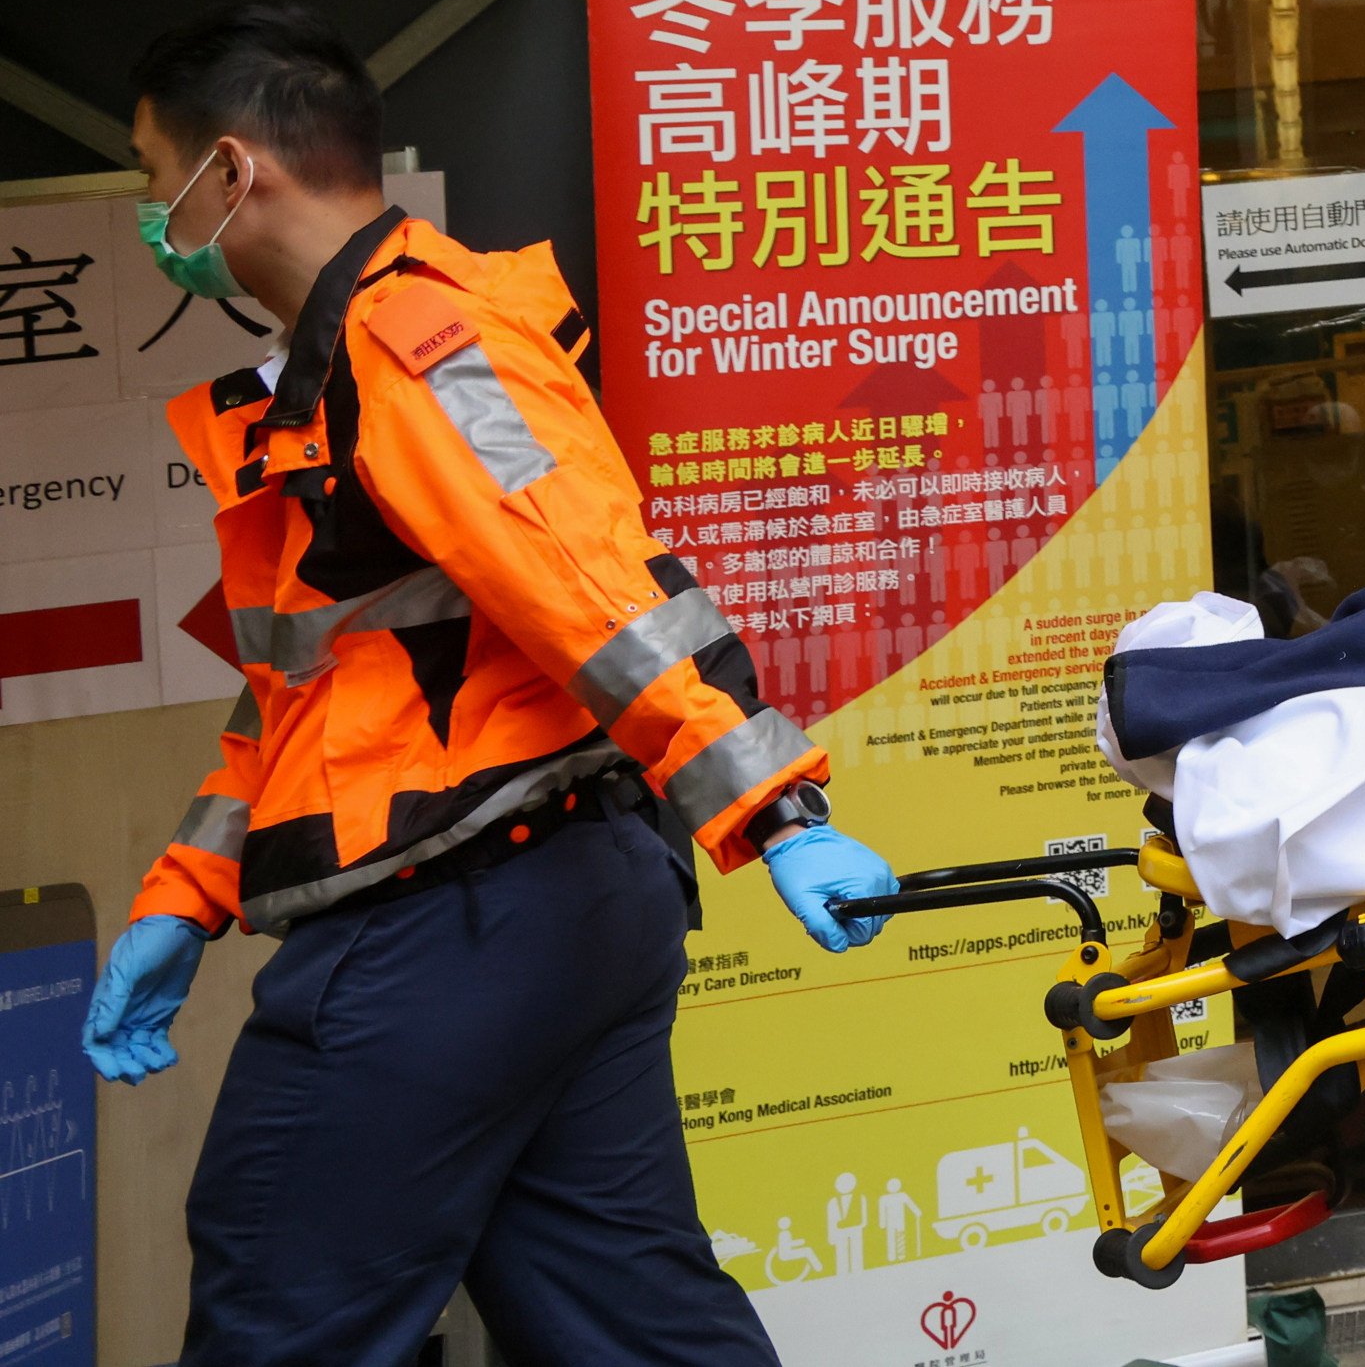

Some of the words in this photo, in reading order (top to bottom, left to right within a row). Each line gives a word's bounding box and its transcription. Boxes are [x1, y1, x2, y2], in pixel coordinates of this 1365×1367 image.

[634, 56, 952, 165] 高峰期
[636, 158, 1062, 274] 特別通告
[1218, 246, 1257, 260] Please
[1261, 244, 1282, 257] use
[1285, 238, 1348, 254] Automatic
[644, 291, 788, 337] Special
[798, 277, 1078, 328] Announcement
[645, 339, 702, 379] for
[712, 332, 838, 373] Winter
[848, 328, 958, 371] Surge
[0, 473, 125, 510] rgency
[1024, 618, 1033, 631] A
[1036, 615, 1082, 631] sudden
[1086, 612, 1121, 628] surge
[1125, 609, 1136, 622] in
[1030, 633, 1042, 647] in
[1045, 631, 1085, 645] recent
[1090, 628, 1119, 643] days
[1007, 649, 1064, 665] extended
[1070, 646, 1089, 659] the
[919, 676, 975, 692] Accident
[979, 672, 988, 685] &
[992, 667, 1061, 683] Emergency
[930, 694, 950, 707] will
[953, 693, 983, 704] occur
[986, 689, 1005, 701] due
[1008, 687, 1019, 698] to
[1021, 683, 1039, 696] full
[1041, 680, 1098, 696] occupancy
[1020, 699, 1062, 712] Patients
[1066, 695, 1085, 707] will
[1087, 694, 1100, 705] be
[866, 733, 915, 747] Accident
[917, 730, 926, 741] &
[929, 725, 988, 741] Emergency
[990, 715, 1052, 733] Department
[1055, 712, 1084, 725] while
[922, 744, 939, 757] We
[942, 739, 999, 756] appreciate
[1001, 736, 1024, 749] your
[973, 753, 1022, 767] Members
[1025, 749, 1036, 760] of
[1038, 746, 1055, 759] the
[1058, 743, 1091, 758] public
[1060, 759, 1097, 774] private
[999, 784, 1034, 797] Please
[1037, 777, 1076, 792] browse
[1078, 776, 1096, 786] the
[1086, 791, 1101, 802] for
[1104, 788, 1131, 800] more
[704, 976, 736, 992] Care
[739, 967, 802, 986] Directory
[681, 1115, 715, 1131] Hong
[718, 1108, 753, 1124] Kong
[757, 1099, 811, 1118] Medical
[813, 1086, 893, 1109] Association
